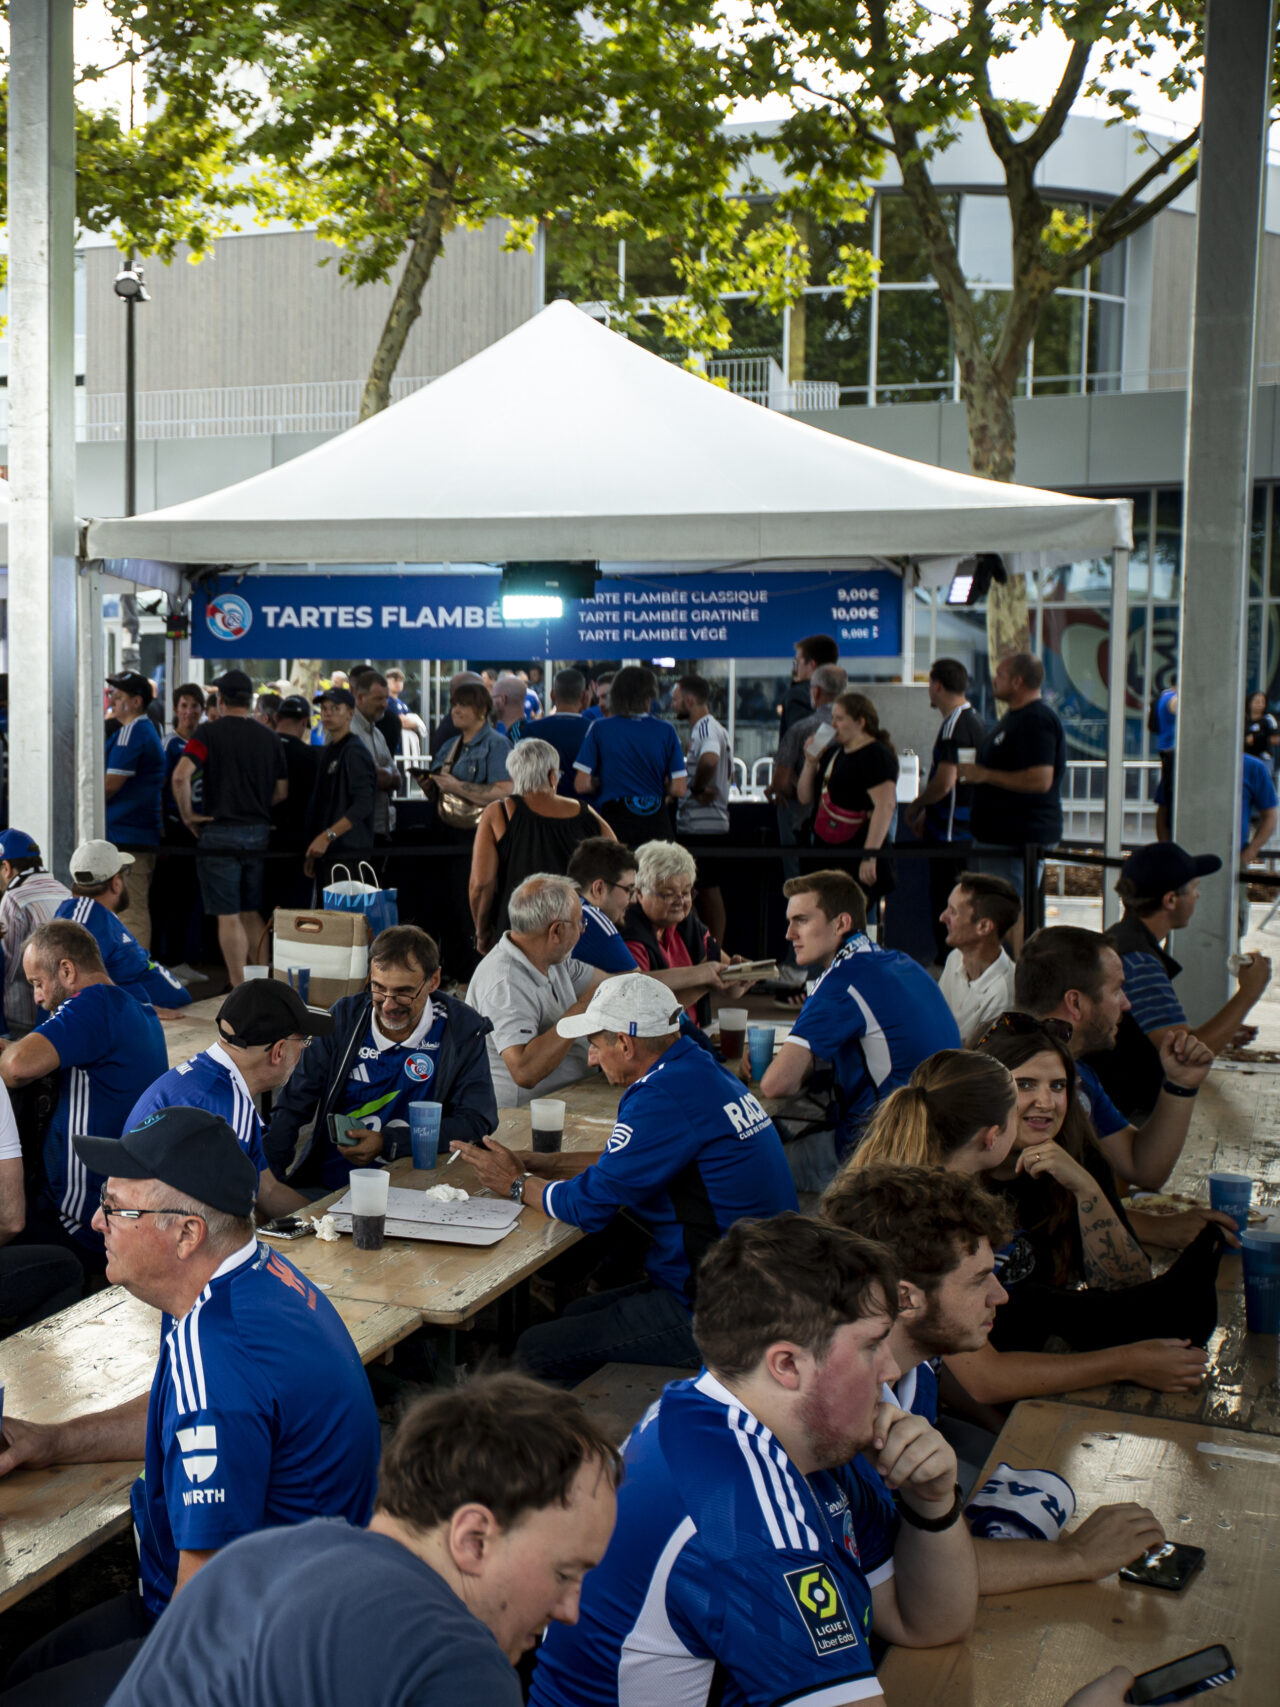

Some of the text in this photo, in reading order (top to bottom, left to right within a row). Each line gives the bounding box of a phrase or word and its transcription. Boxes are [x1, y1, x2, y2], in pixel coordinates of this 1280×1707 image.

[624, 589, 688, 604] FLAMBÉE
[691, 590, 768, 604] CLASSIQUE
[262, 605, 372, 628] TARTES
[381, 601, 540, 628] FLAMBÉ
[578, 607, 760, 623] TARTE FLAMBÉE GRATINÉE
[831, 606, 879, 622] 10,00€
[578, 625, 727, 641] TARTE FLAMBÉE VÉGÉ
[816, 1620, 848, 1636] LIGUE 1
[818, 1633, 854, 1650] Uber Eats
